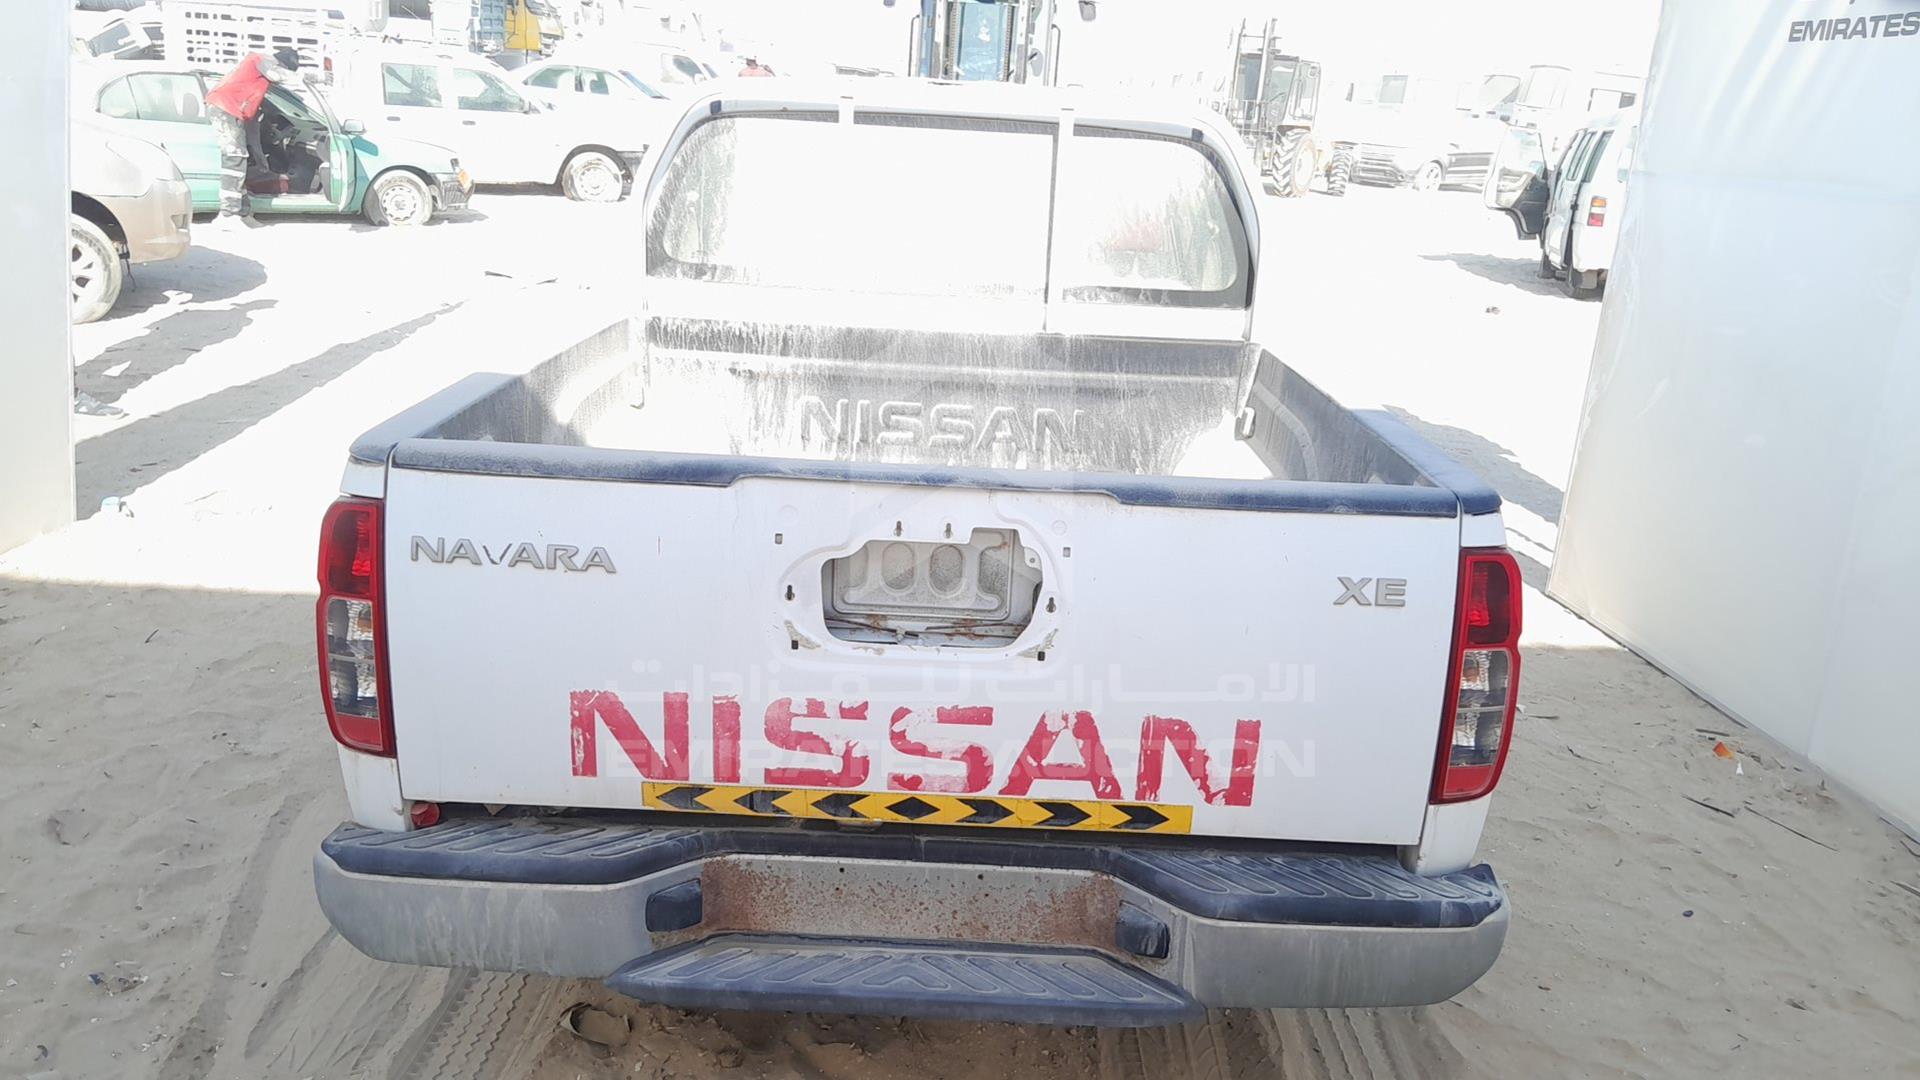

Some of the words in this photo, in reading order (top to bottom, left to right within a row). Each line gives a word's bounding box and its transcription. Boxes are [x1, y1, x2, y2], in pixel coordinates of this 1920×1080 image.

[1788, 12, 1920, 42] EMIRATES
[799, 395, 1086, 456] NISSAN
[410, 535, 617, 574] NAVARA
[1332, 576, 1408, 607] XE
[569, 689, 1262, 807] NISSAN
